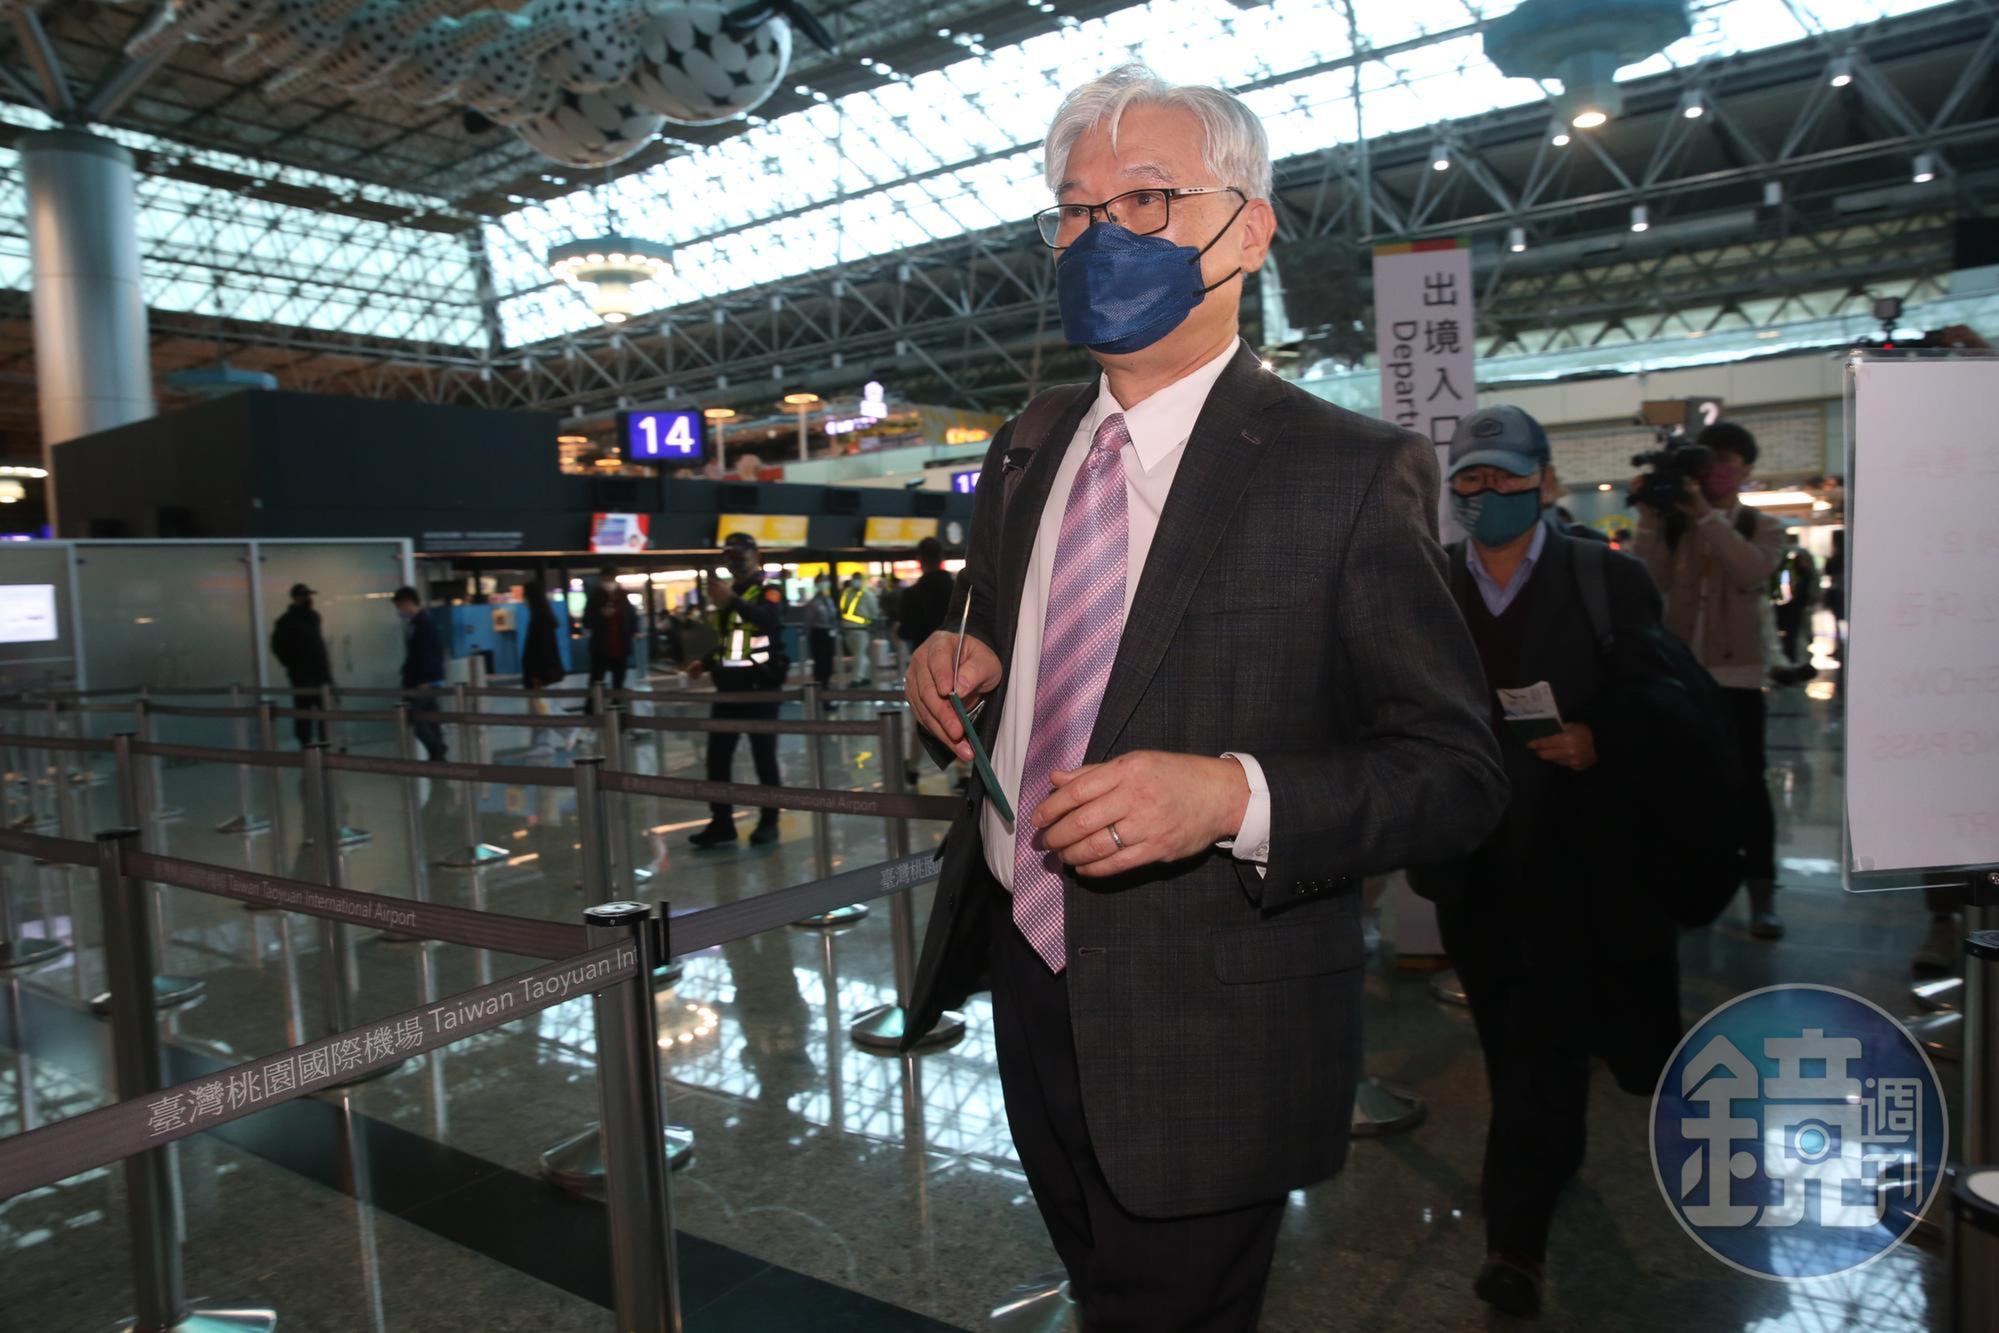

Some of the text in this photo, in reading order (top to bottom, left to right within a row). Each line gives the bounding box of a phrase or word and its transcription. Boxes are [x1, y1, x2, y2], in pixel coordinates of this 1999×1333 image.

[1387, 320, 1419, 428] Depart
[1423, 271, 1463, 446] 出境入口
[637, 415, 696, 455] 14
[838, 798, 877, 813] Airport
[228, 874, 261, 897] Taiwan
[262, 881, 303, 905] Taoyuan
[305, 888, 373, 918] International
[374, 902, 416, 928] Airport
[146, 1017, 424, 1137] 臺灣桃園國際機場
[428, 991, 515, 1034] Taiwan
[517, 958, 611, 1004] Taoyuan
